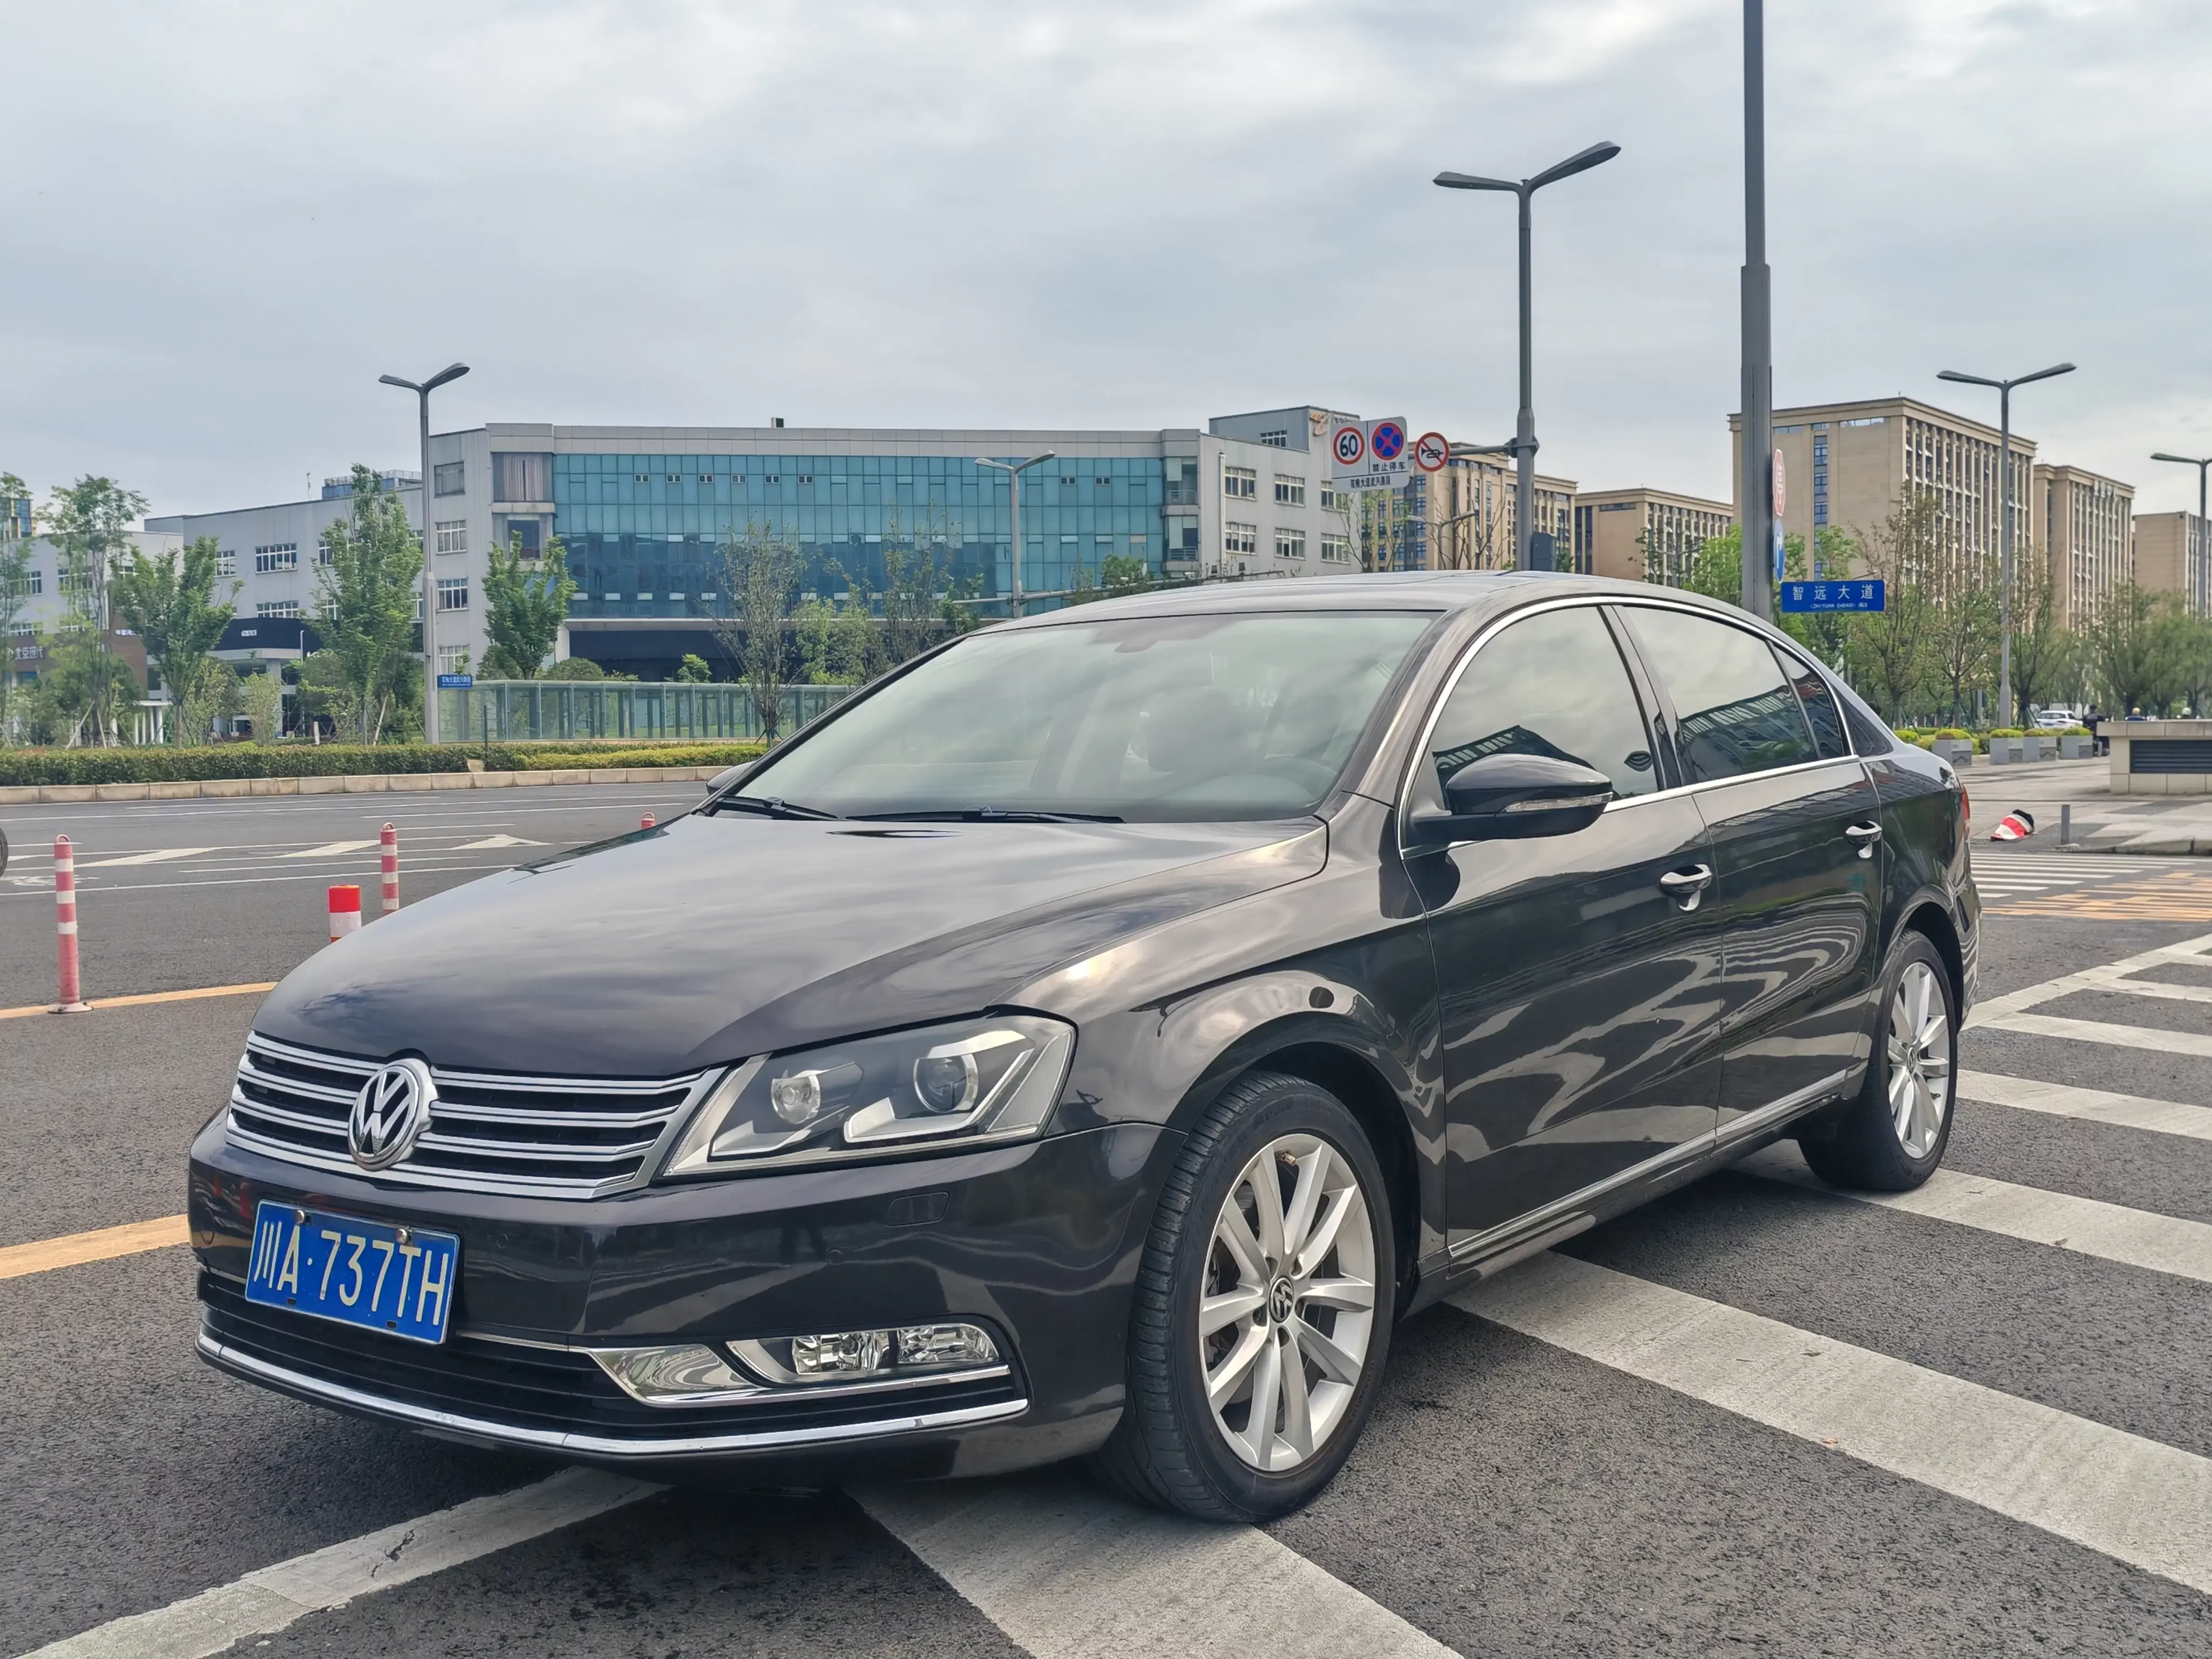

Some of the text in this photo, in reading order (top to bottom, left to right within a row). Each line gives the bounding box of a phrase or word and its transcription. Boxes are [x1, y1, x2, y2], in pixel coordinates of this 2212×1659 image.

[1340, 434, 1358, 457] 60
[1372, 462, 1406, 472] 禁止停车
[1792, 584, 1874, 601] 智远大道
[254, 1219, 449, 1326] 川A·737TH
